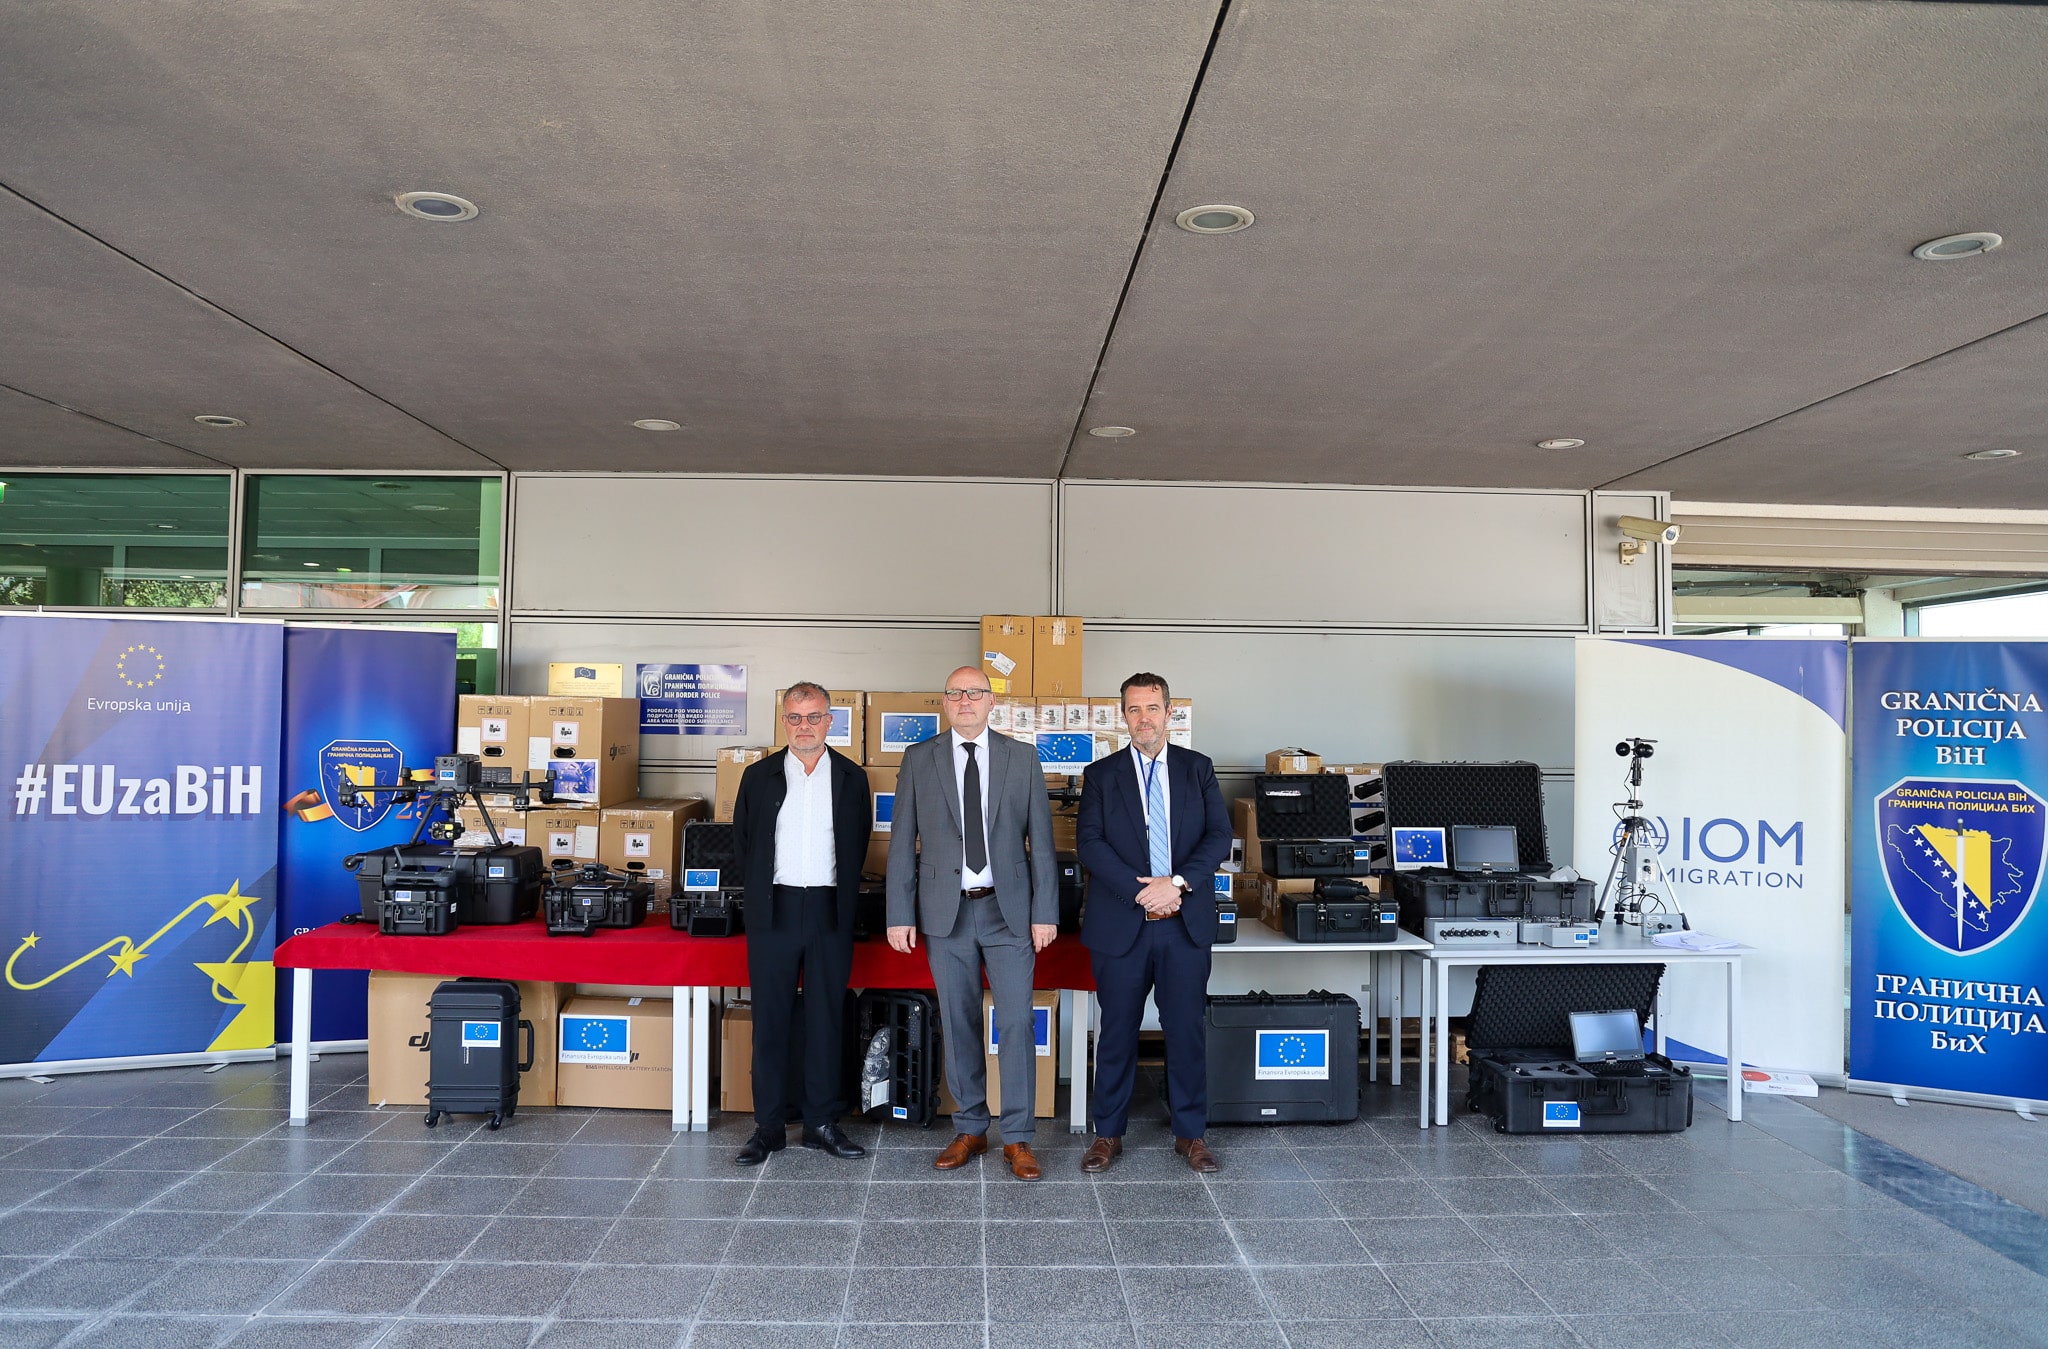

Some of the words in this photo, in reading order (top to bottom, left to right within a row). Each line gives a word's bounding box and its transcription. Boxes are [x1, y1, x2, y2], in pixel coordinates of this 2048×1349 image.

[87, 697, 152, 713] Evropska
[156, 699, 191, 715] unija
[675, 691, 699, 699] BORDER
[1880, 687, 2043, 713] GRANIČNA
[1895, 718, 2027, 744] POLICIJA
[1935, 746, 1986, 766] BiH
[15, 763, 262, 815] #EUzaBiH
[1896, 787, 1953, 799] GRANIČNA
[1955, 789, 2006, 801] POLICIJA
[2008, 792, 2027, 802] BIH
[1887, 799, 1945, 810] ГРАНИЧНА
[1947, 802, 2009, 813] ПОЛИЦИЈА
[2011, 804, 2036, 814] БИХ
[1682, 816, 1804, 866] IOM
[1659, 867, 1804, 889] MIGRATION
[1875, 974, 2045, 1007] ГРАНИЧНА
[1873, 999, 2047, 1036] ПОЛИЦИЈА
[1930, 1030, 1987, 1055] БиХ
[1284, 1069, 1310, 1077] Evropska
